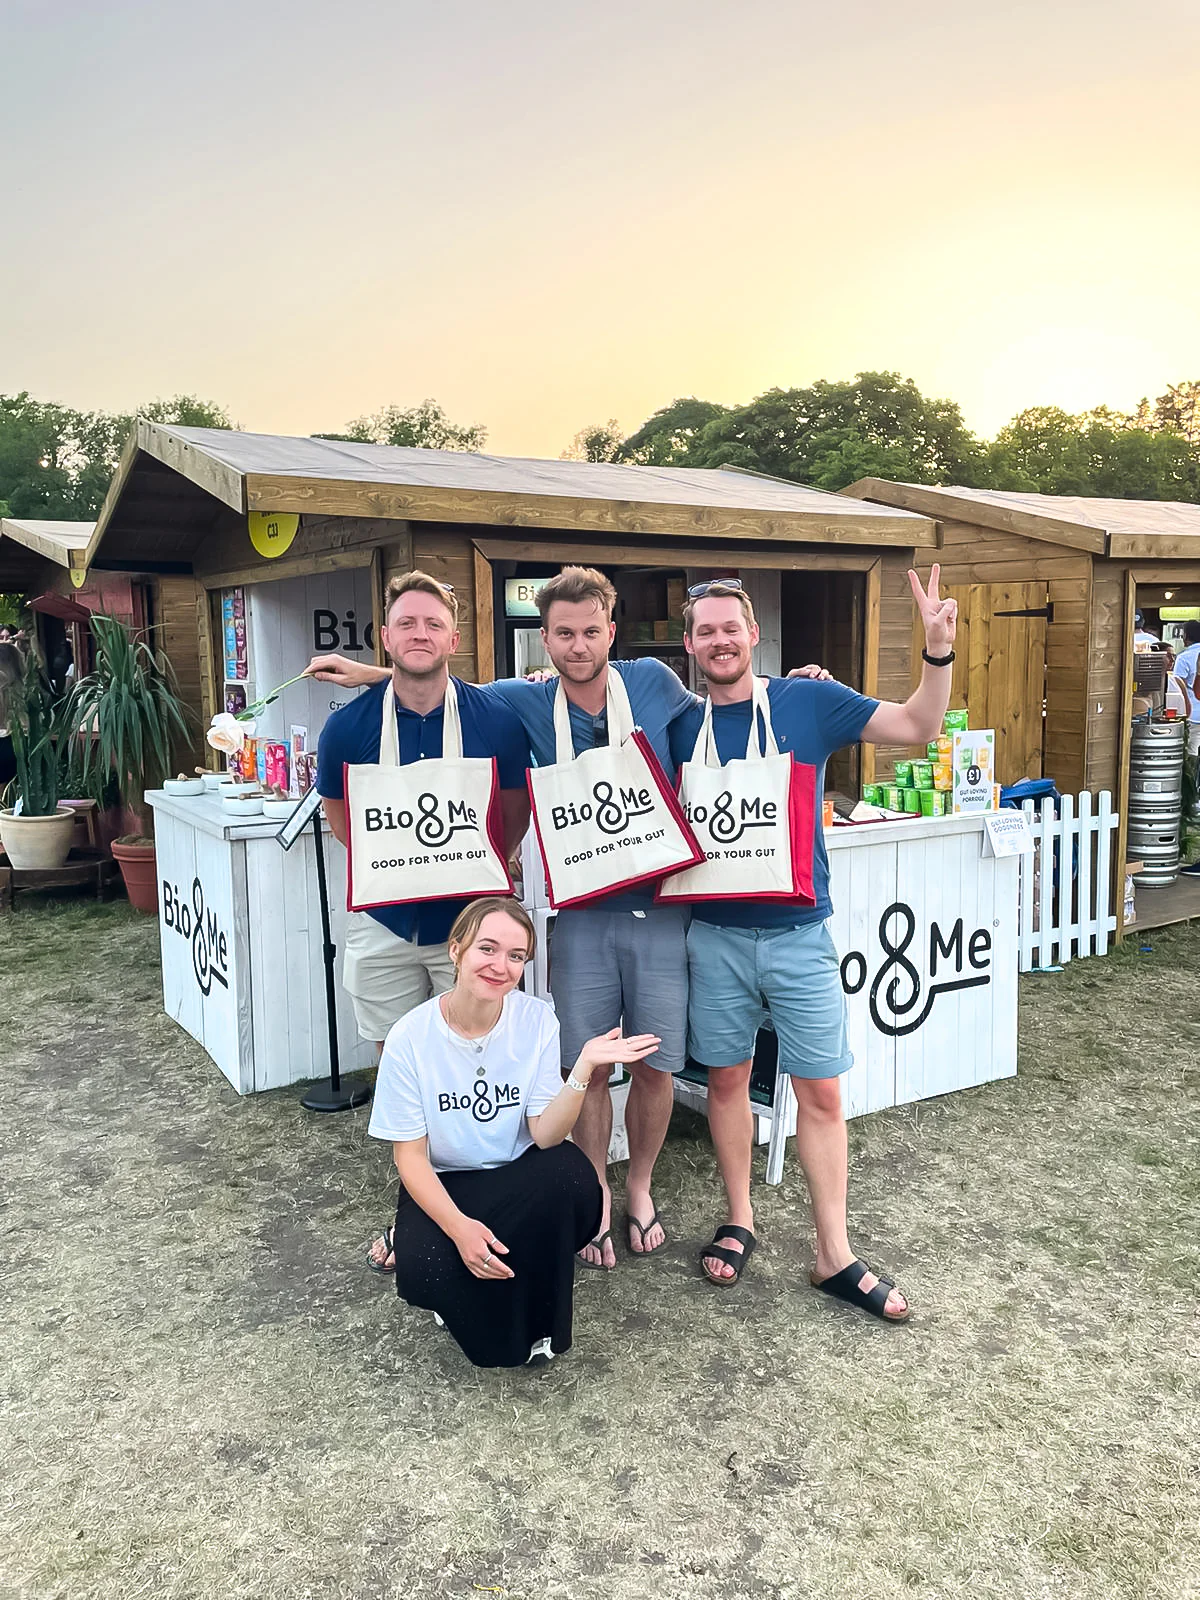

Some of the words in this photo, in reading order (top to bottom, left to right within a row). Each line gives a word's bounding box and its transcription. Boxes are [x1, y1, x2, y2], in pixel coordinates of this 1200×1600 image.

[564, 850, 594, 866] GOOD
[596, 843, 616, 856] FOR
[616, 836, 643, 849] YOUR
[645, 829, 666, 841] GUT
[723, 849, 752, 859] YOUR
[755, 848, 776, 858] GUT
[371, 858, 405, 870] GOOD
[409, 855, 430, 866] FOR
[433, 851, 463, 863] YOUR
[466, 849, 487, 860] GUT
